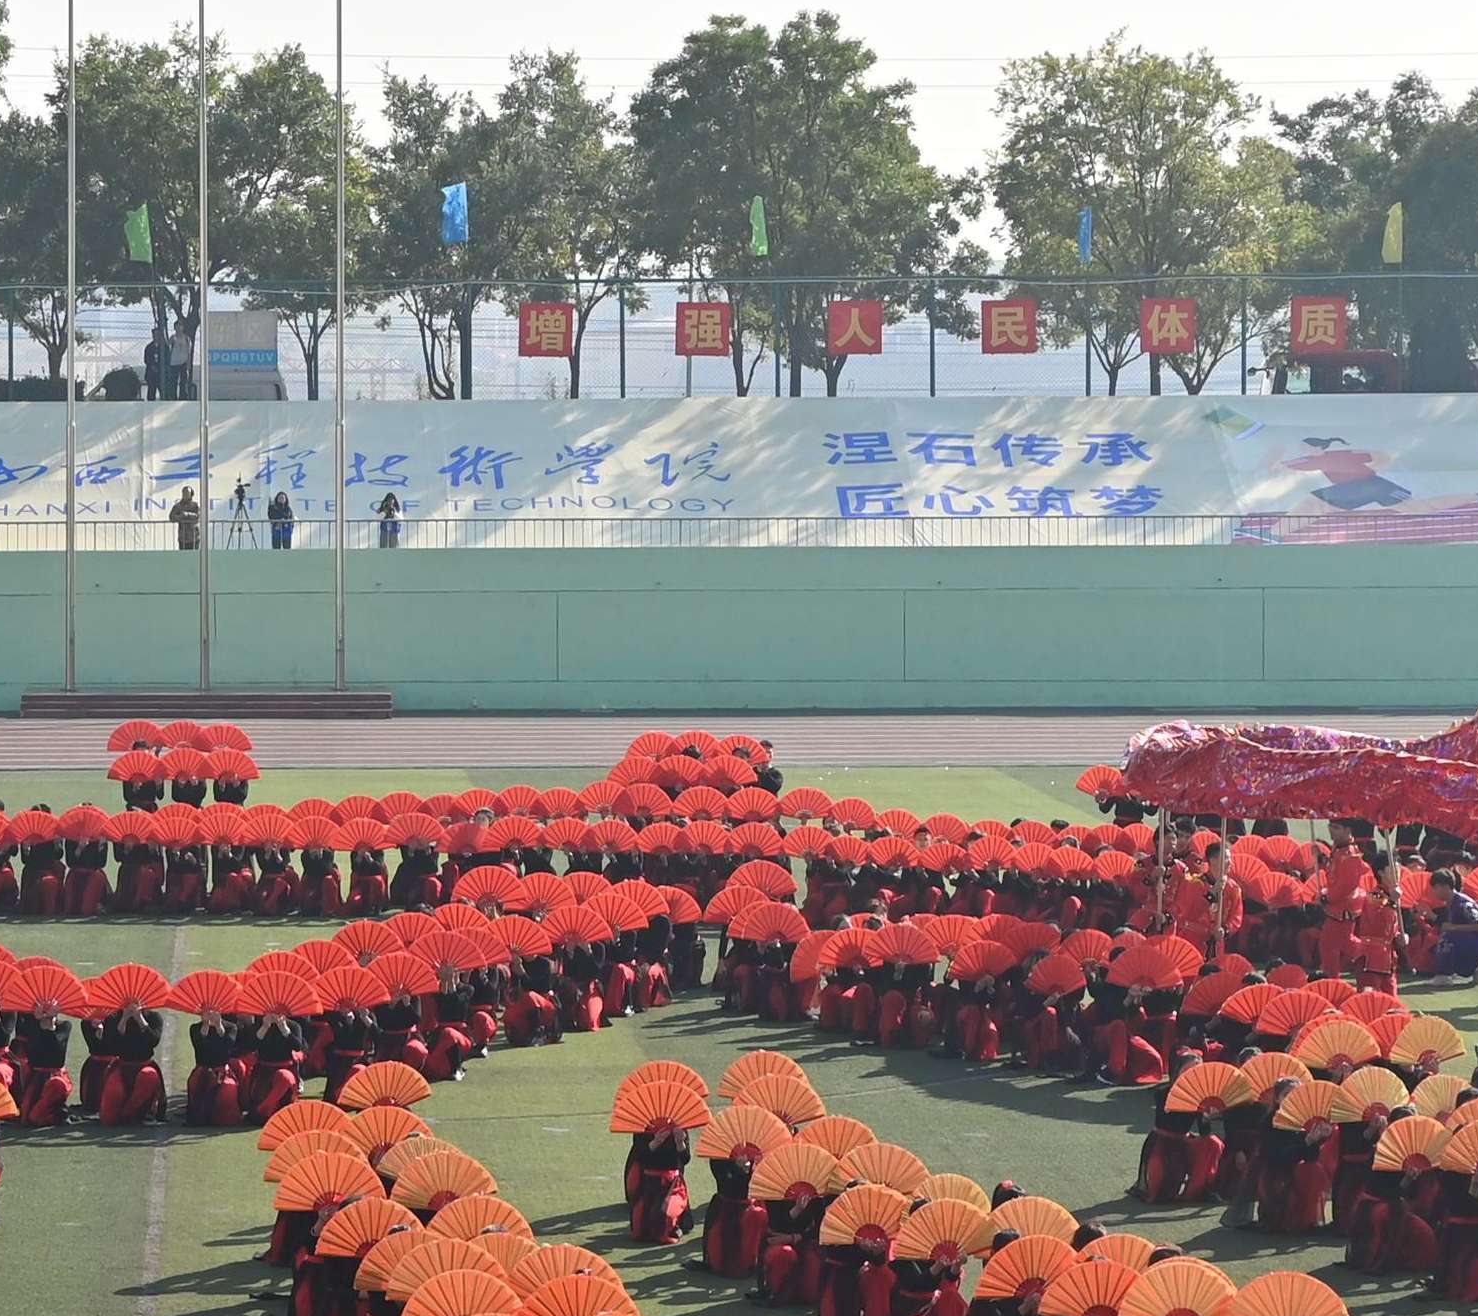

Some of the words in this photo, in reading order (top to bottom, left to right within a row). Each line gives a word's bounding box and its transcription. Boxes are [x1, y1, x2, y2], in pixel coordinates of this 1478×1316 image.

[525, 309, 567, 351] 增
[684, 308, 724, 350] 强
[834, 307, 876, 348] 人
[989, 305, 1029, 348] 民
[1146, 305, 1189, 346] 体
[1297, 303, 1338, 345] 质
[822, 431, 1153, 468] 涅石传承
[134, 497, 337, 513] INTITTE
[444, 495, 734, 512] TECHNOLOGY
[835, 483, 1165, 517] 匠心筑梦
